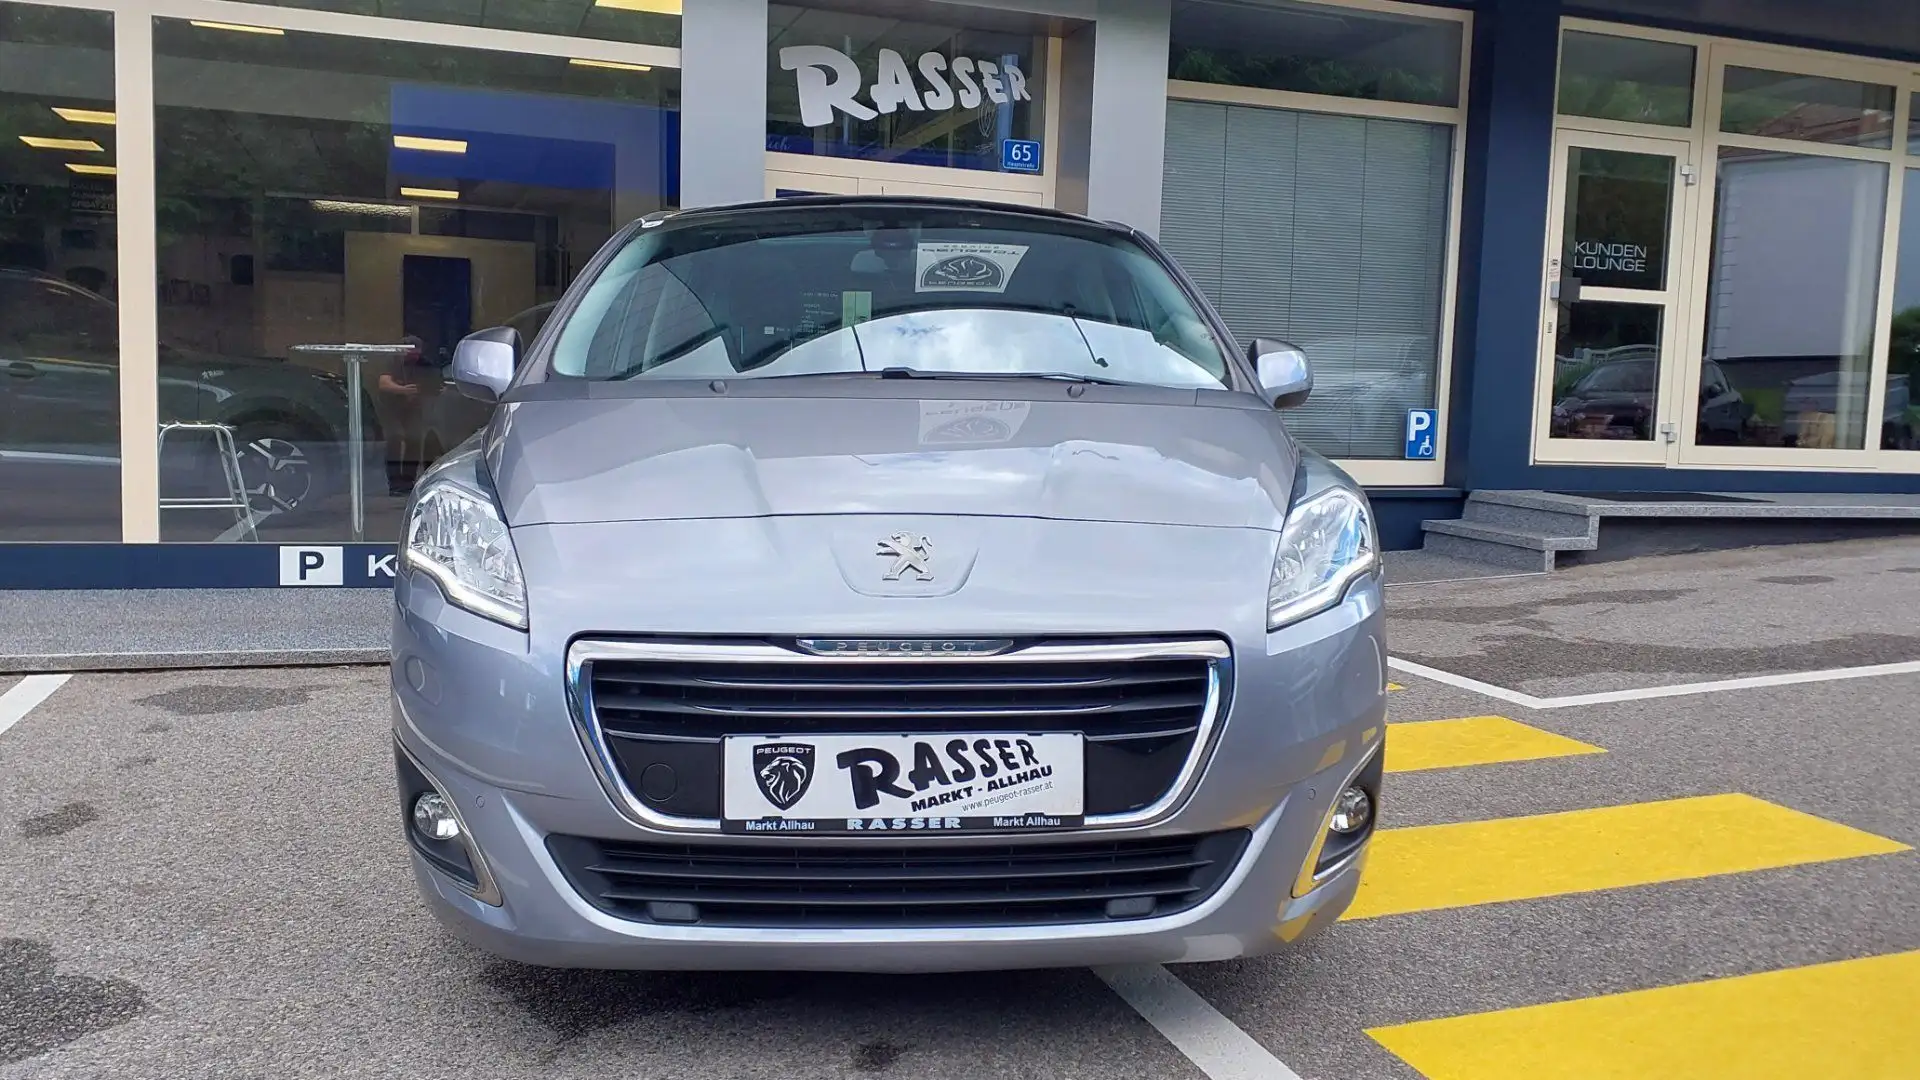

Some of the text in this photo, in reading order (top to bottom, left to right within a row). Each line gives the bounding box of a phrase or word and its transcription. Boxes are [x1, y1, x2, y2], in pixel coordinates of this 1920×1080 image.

[779, 45, 1031, 127] RASSER
[1011, 144, 1031, 161] 65
[1575, 241, 1647, 258] KUNDEN
[1573, 256, 1646, 272] LOUNGE
[1409, 411, 1431, 441] P
[299, 551, 324, 580] P
[836, 641, 976, 652] PEUGEOT
[756, 746, 812, 755] PEUGEOT
[836, 739, 1040, 810] RASSER
[911, 786, 974, 812] MARKT
[987, 765, 1053, 792] ALLHAU
[962, 780, 1053, 812] www.peugeot-rasser.at
[746, 820, 815, 830] Markt Allhau
[847, 817, 961, 830] RASSER
[993, 816, 1061, 827] Markt Allhau
